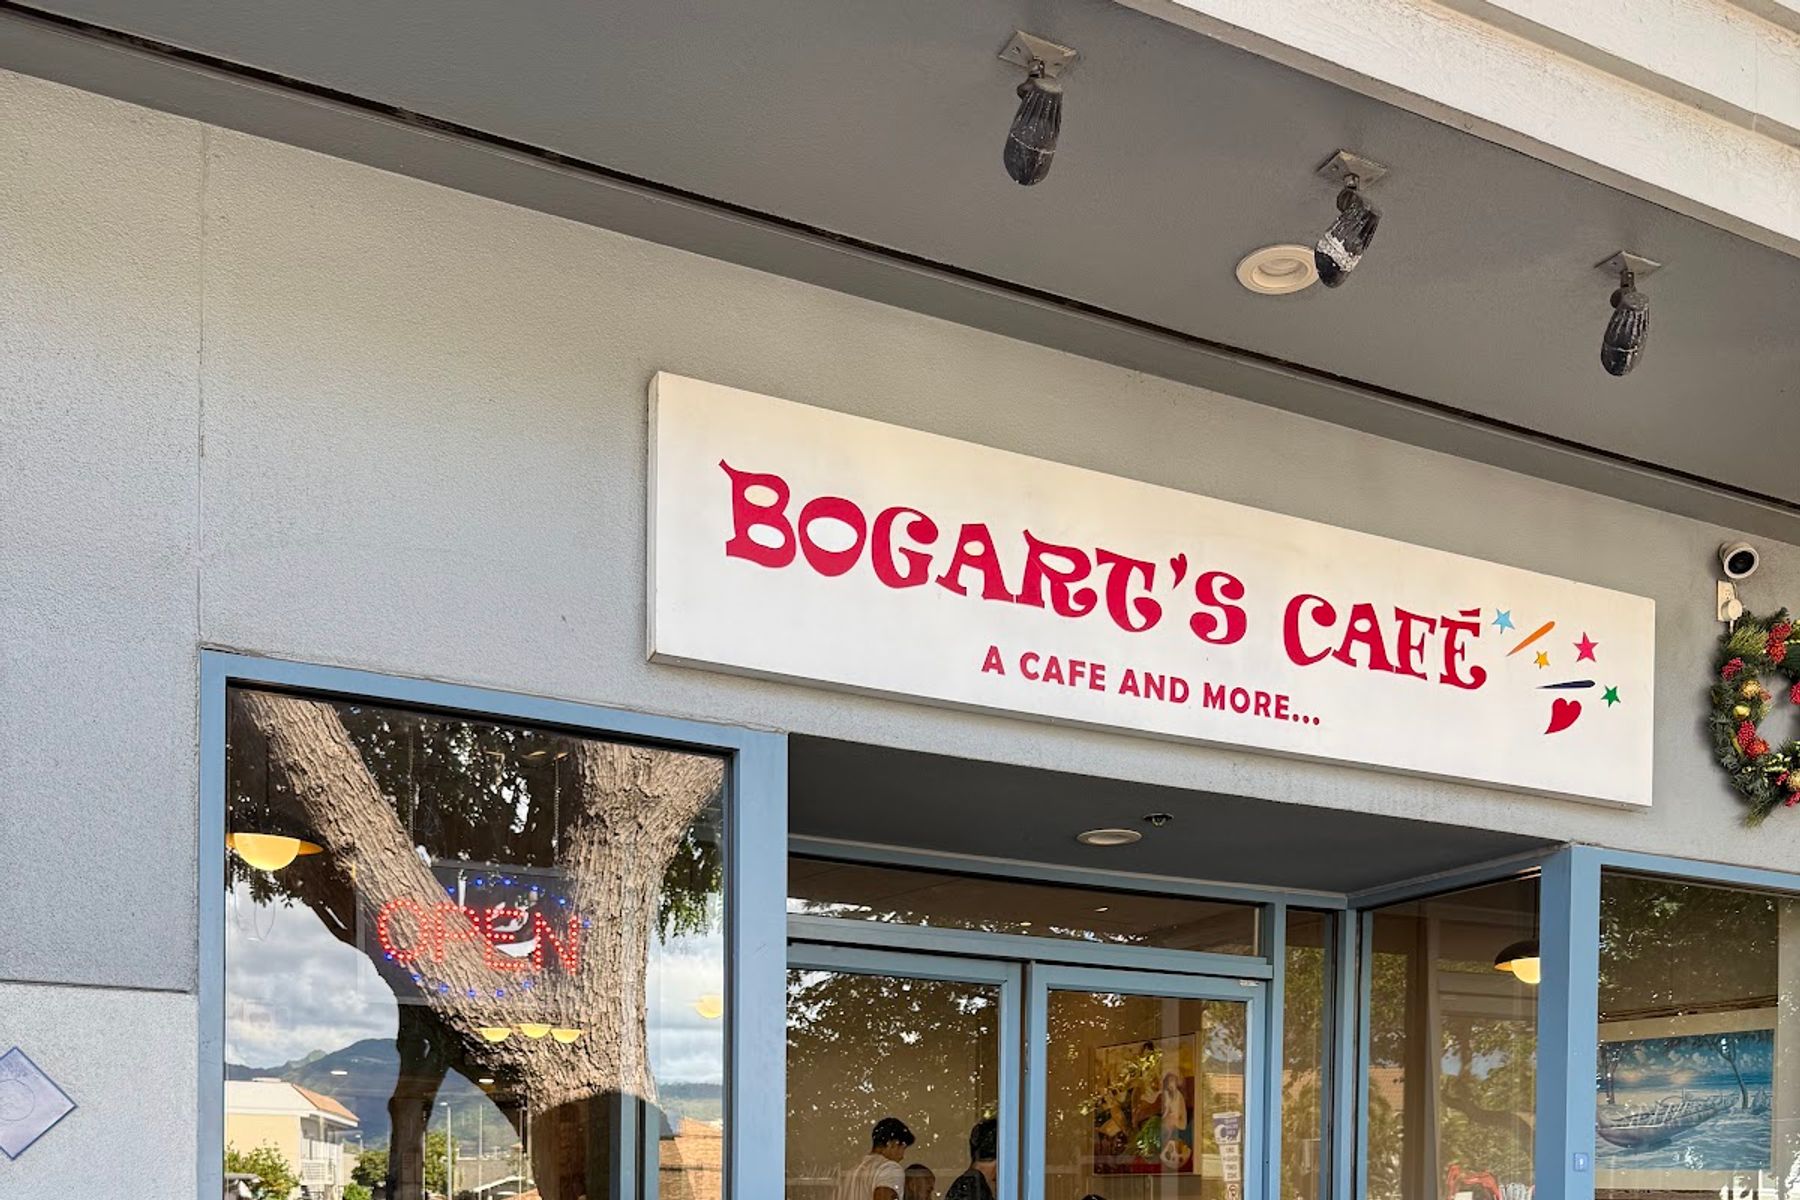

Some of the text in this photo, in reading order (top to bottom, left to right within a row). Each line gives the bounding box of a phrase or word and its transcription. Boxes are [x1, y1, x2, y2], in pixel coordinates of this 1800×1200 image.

[719, 458, 1487, 690] BOGART'S CAFÉ
[981, 645, 1320, 726] A CAFE AND MORE...
[377, 897, 578, 976] OPEN
